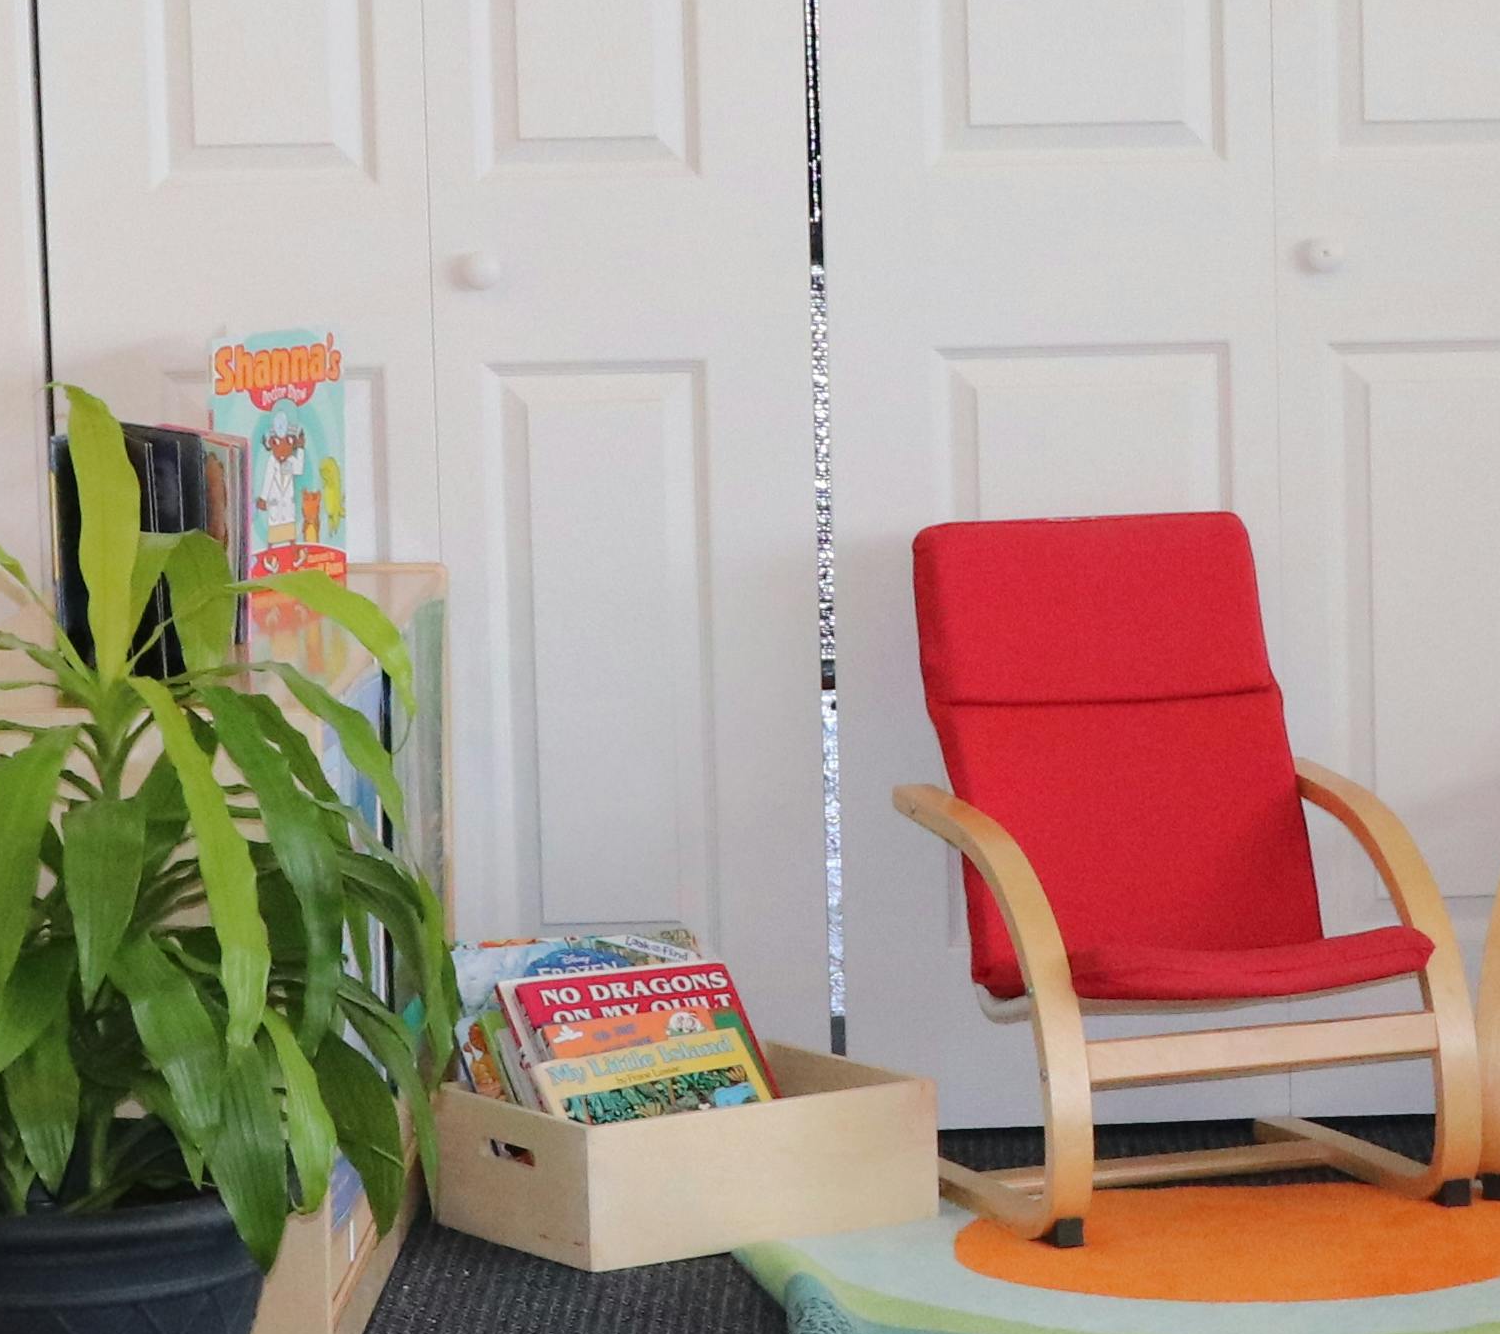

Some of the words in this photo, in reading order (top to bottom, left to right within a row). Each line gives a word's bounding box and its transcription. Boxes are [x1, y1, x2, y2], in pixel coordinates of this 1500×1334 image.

[214, 332, 341, 395] Shanna's
[540, 986, 581, 1006] NO
[588, 971, 729, 1001] DRAGONS
[553, 1007, 592, 1023] ON
[600, 1002, 639, 1018] MY
[650, 993, 732, 1012] QUILT
[548, 1064, 587, 1086] My
[587, 1049, 654, 1077] Little
[657, 1034, 736, 1061] Island
